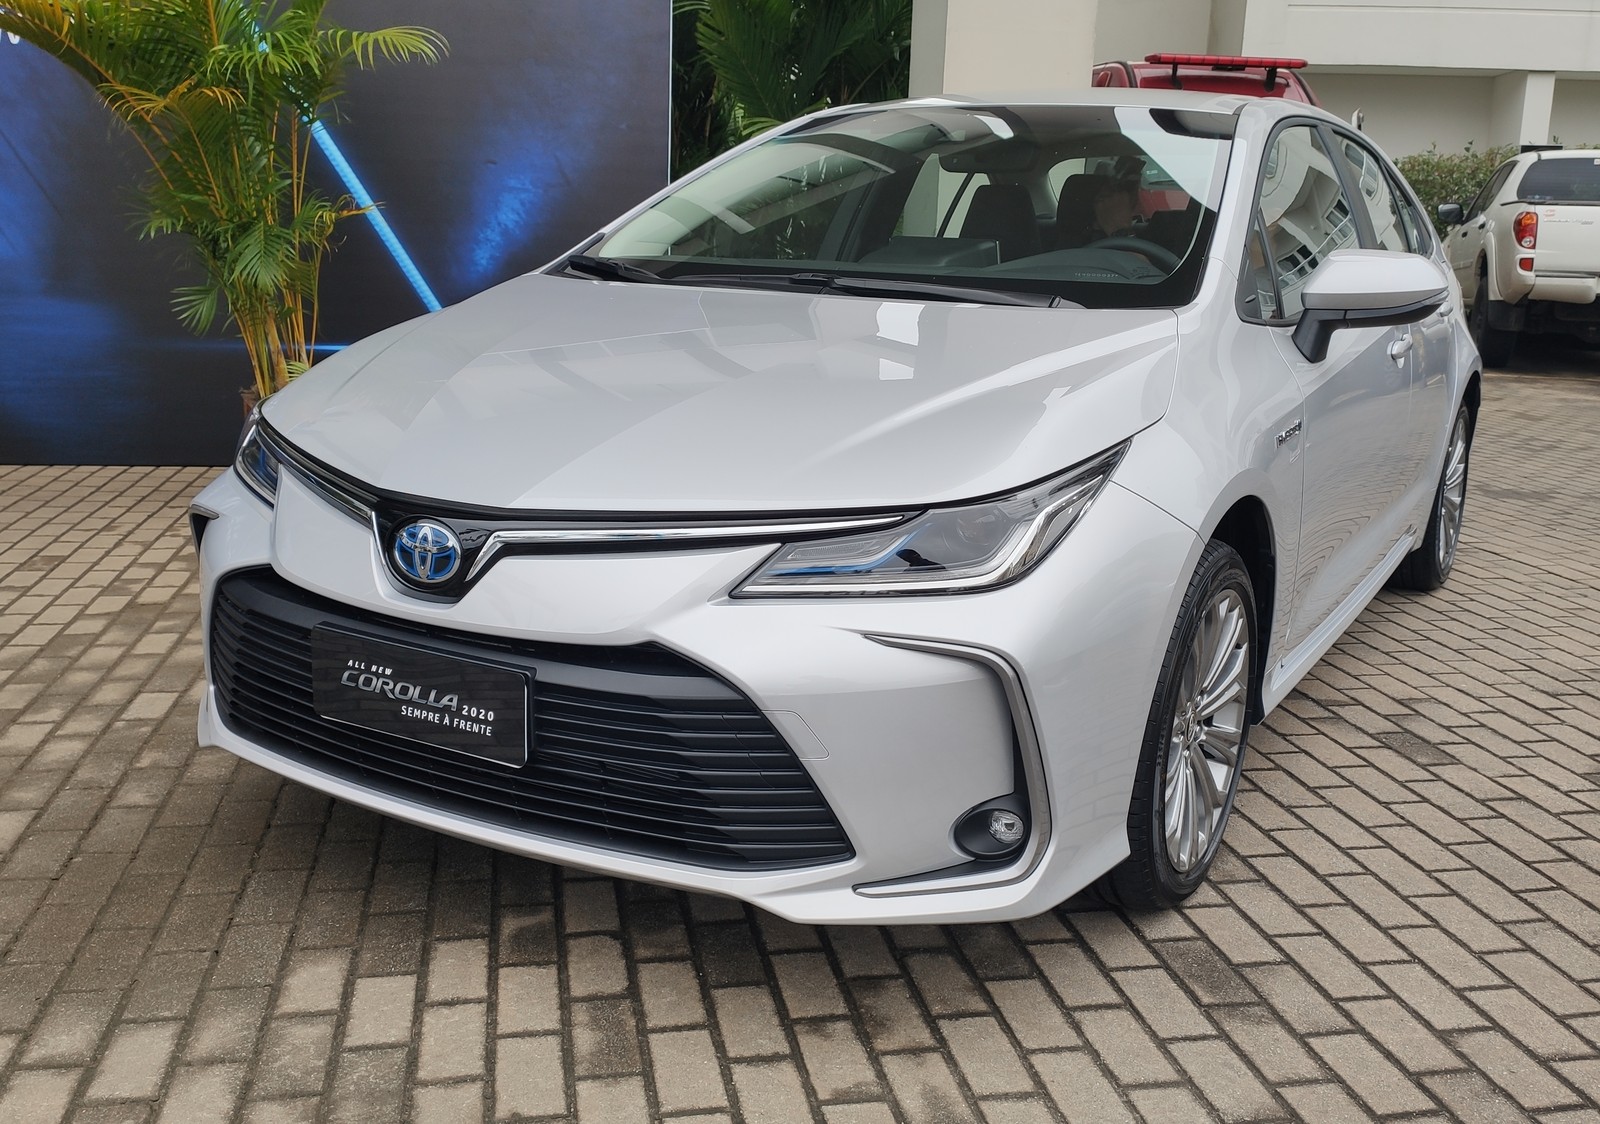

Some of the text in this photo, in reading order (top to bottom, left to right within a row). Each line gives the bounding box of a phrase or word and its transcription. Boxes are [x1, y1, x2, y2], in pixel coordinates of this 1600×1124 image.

[347, 659, 393, 676] ALL NEW
[340, 669, 494, 721] COROLLA 2020
[400, 705, 492, 737] SEMPRE À FRENTE
